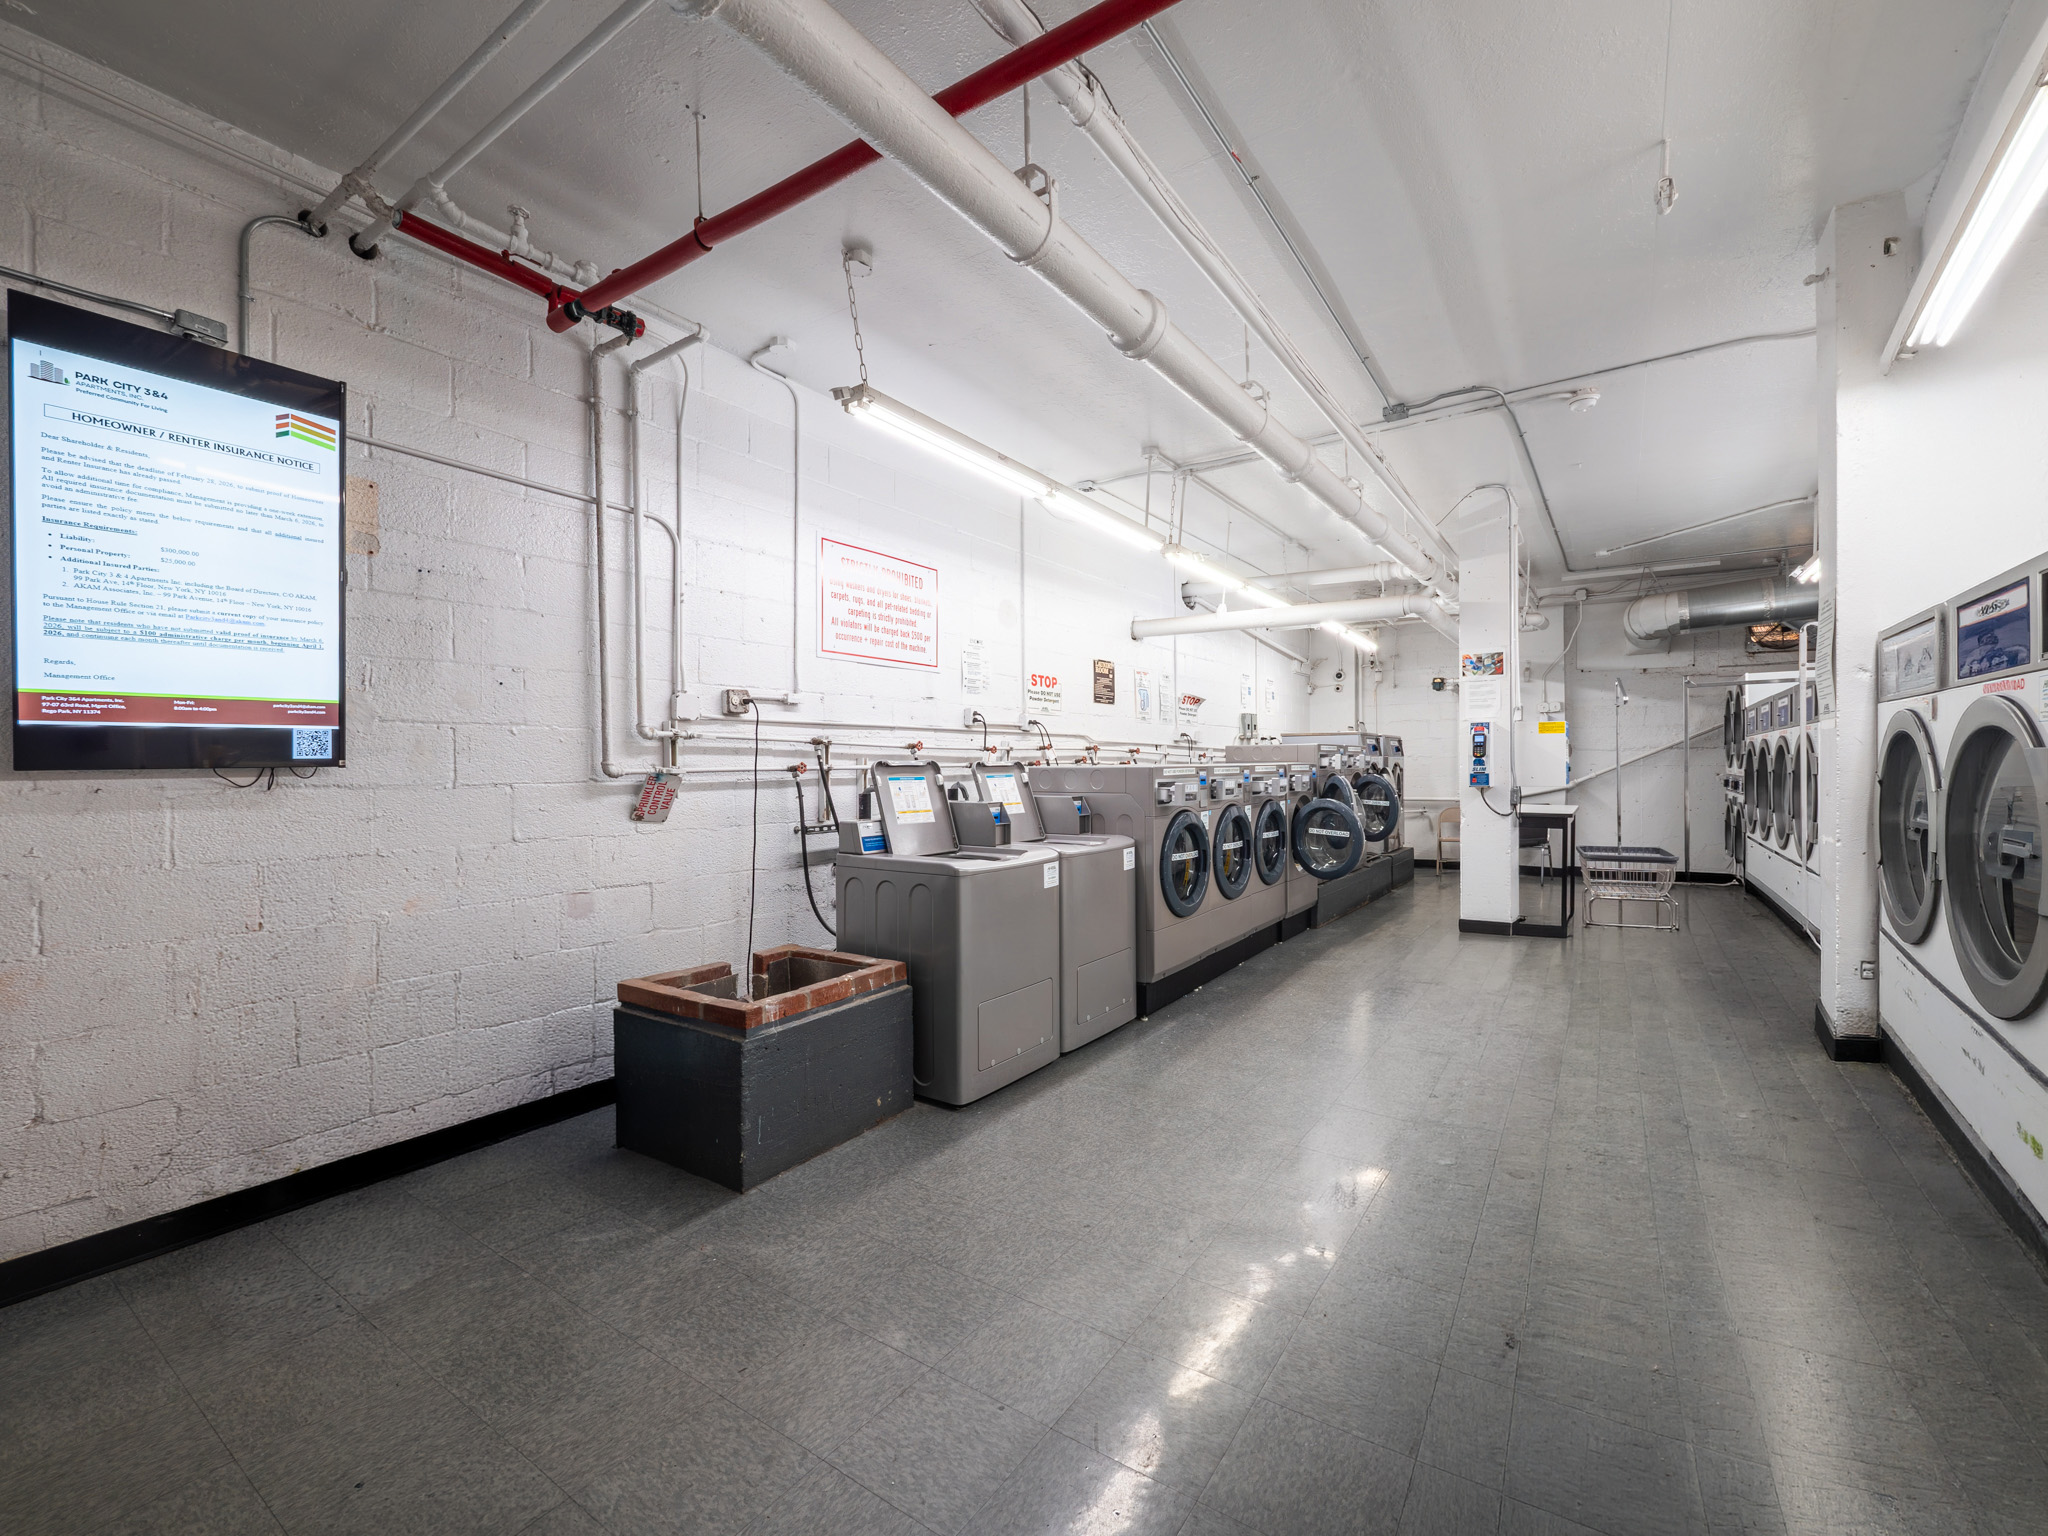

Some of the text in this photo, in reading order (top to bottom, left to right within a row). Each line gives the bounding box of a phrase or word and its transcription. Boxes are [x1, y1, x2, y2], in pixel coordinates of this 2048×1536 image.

[75, 371, 168, 400] PARK CITY 3&4
[76, 388, 105, 398] Preferred
[106, 394, 139, 406] Community
[41, 432, 59, 440] Dear
[61, 436, 104, 449] Shareholder
[72, 412, 155, 437] HOMEOWNER
[169, 433, 210, 448] RENTER
[214, 443, 273, 462] INSURANCE
[277, 456, 313, 470] NOTICE
[57, 457, 81, 466] Renter
[84, 462, 117, 473] Insurance
[132, 472, 156, 480] already
[103, 512, 127, 520] exactly
[42, 516, 138, 535] Insurance Requirements:
[60, 533, 92, 543] Liability:
[60, 544, 131, 558] Personal Property:
[161, 547, 199, 557] $300,000.00
[61, 556, 101, 565] Additional
[103, 561, 131, 569] Insured
[161, 557, 196, 566] $25,000.00
[130, 575, 169, 584] Apartments
[1031, 674, 1057, 688] STOP
[1182, 695, 1200, 706] STOP
[635, 776, 657, 817] SPRINKLER
[648, 782, 667, 815] CONTROL
[660, 788, 676, 810] VALVE
